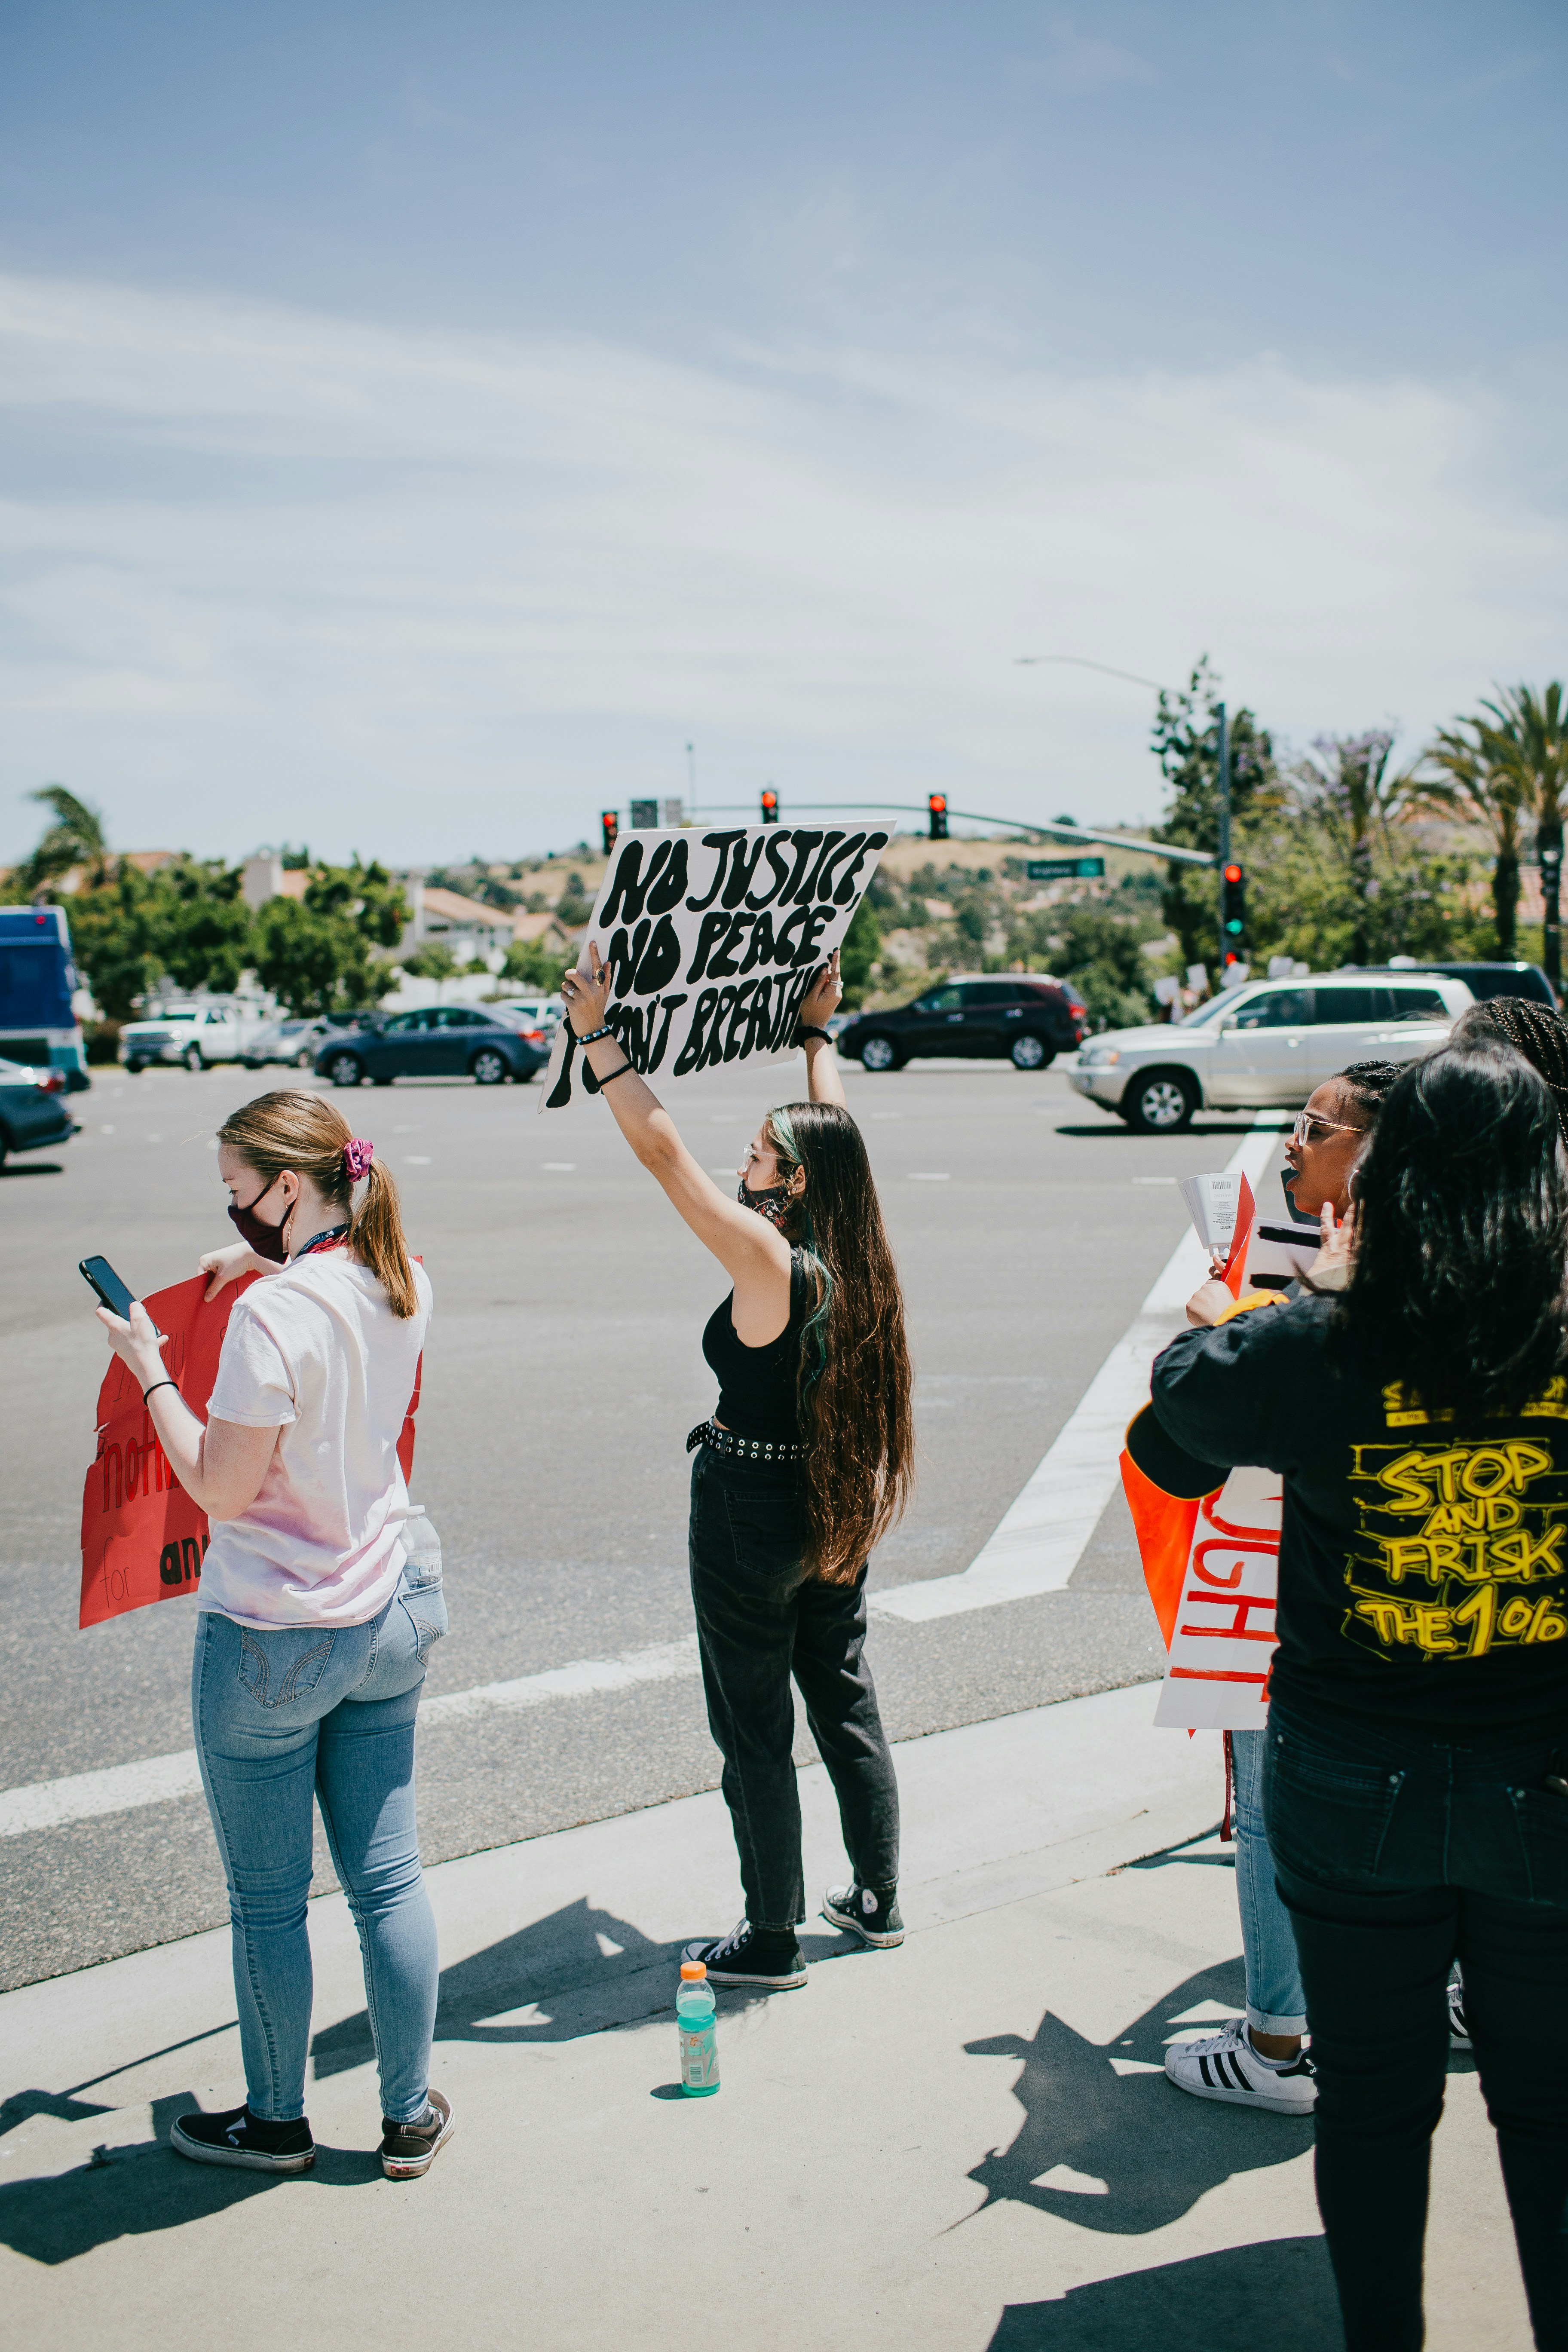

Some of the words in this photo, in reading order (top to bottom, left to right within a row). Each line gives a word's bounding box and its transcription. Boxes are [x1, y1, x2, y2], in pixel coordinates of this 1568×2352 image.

[599, 839, 688, 928] NO
[607, 914, 681, 999] NO
[1378, 1443, 1554, 1515] STOP
[1419, 1496, 1522, 1538] AND
[99, 1537, 129, 1608] for
[1379, 1524, 1566, 1585] FRISK
[1354, 1600, 1458, 1651] THE
[1451, 1581, 1568, 1657] 1%
